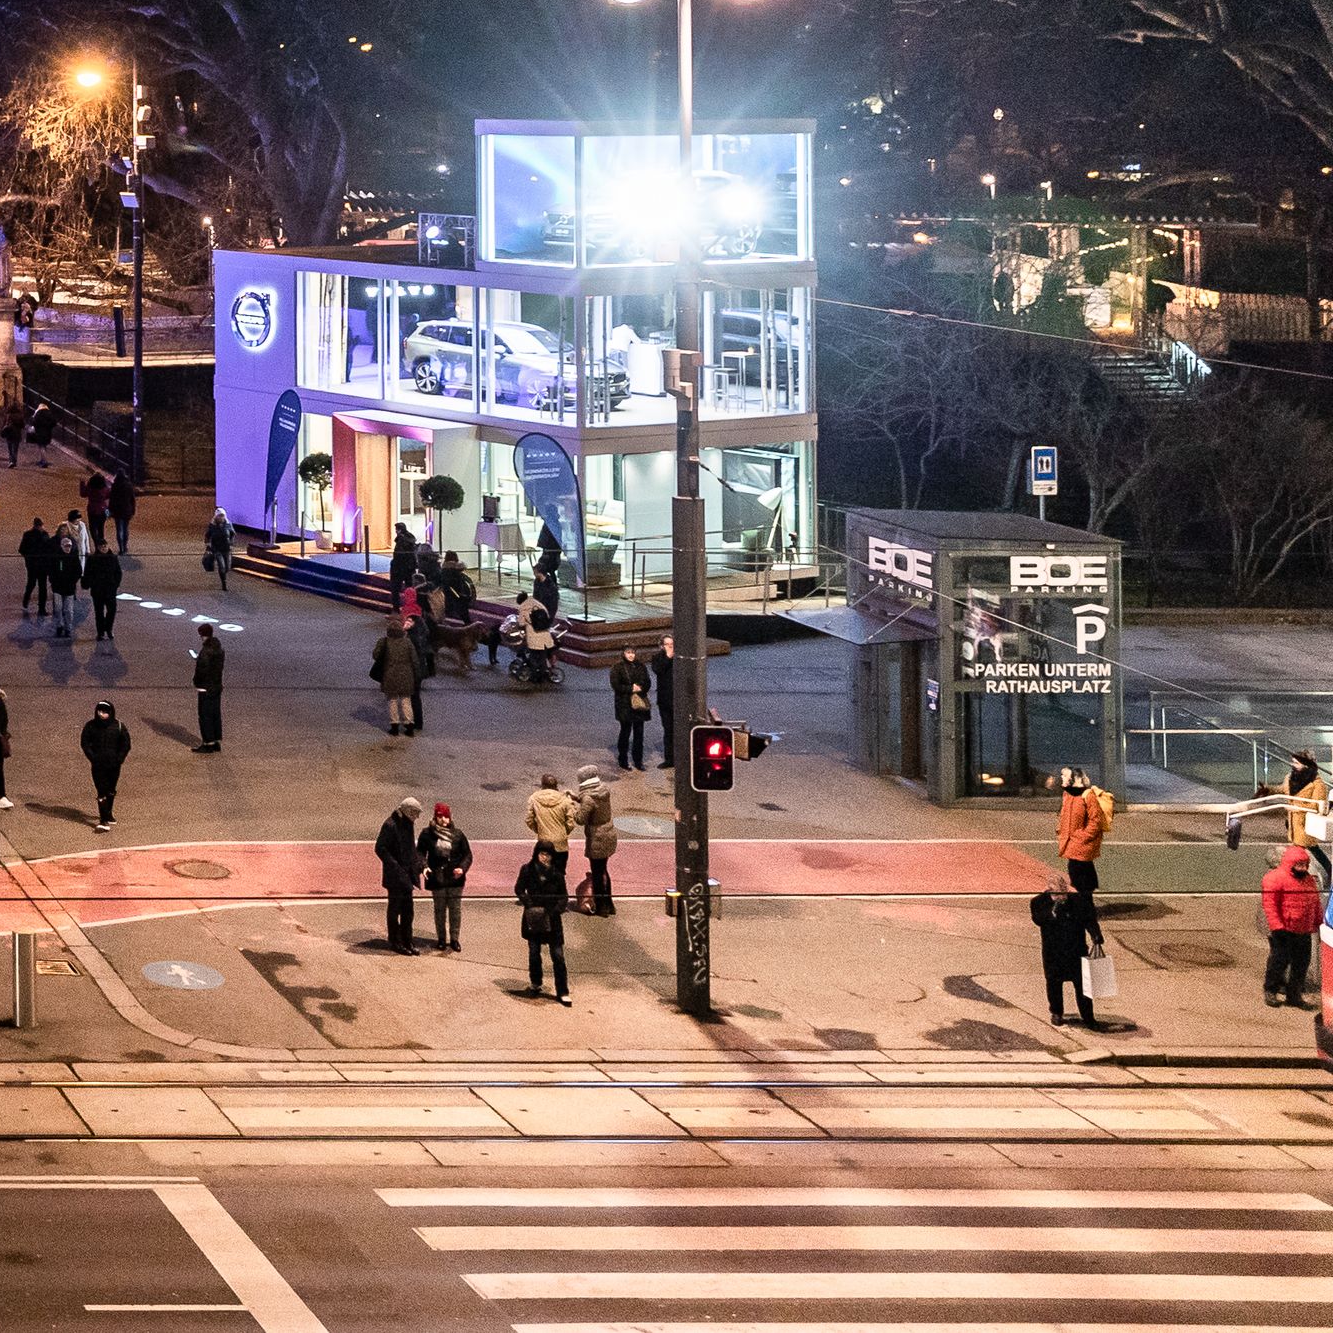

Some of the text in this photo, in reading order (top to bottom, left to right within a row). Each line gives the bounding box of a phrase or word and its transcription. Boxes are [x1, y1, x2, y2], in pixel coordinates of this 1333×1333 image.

[868, 536, 933, 588] BOE
[1010, 555, 1107, 586] BOE
[868, 574, 933, 602] PARKING
[1010, 586, 1108, 594] PARKING
[1076, 616, 1106, 655] P
[974, 663, 1111, 677] PARKEN UNTERM
[985, 679, 1111, 694] RATHAUSPLATZ
